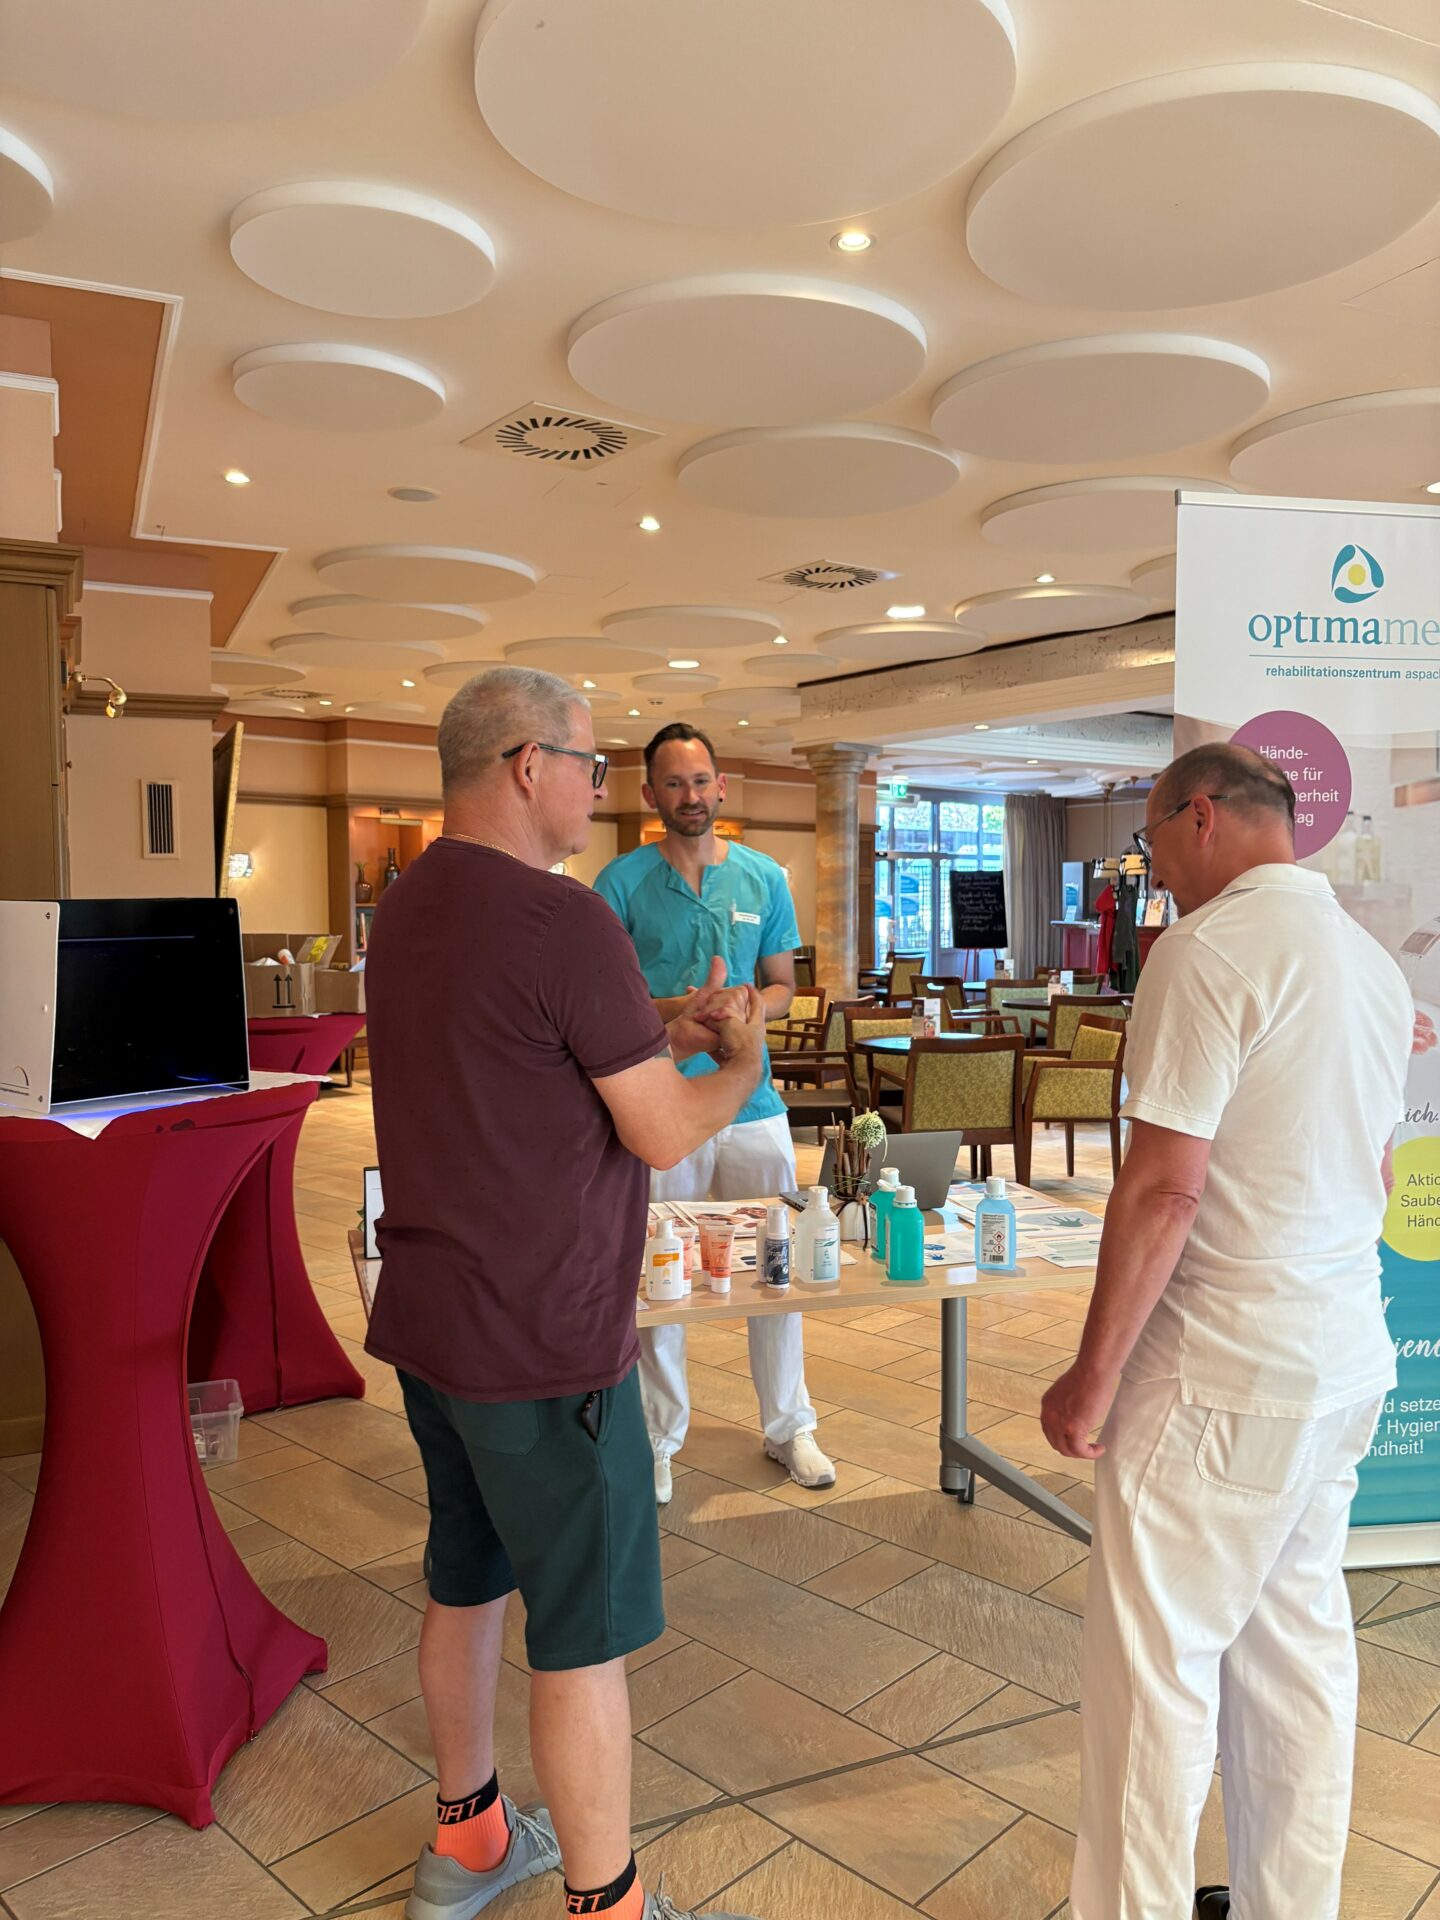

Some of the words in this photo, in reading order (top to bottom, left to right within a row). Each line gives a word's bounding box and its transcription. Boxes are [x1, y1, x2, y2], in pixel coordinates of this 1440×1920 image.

[1266, 665, 1401, 679] rehabilitationszentrum
[1405, 669, 1440, 682] aspac
[1260, 745, 1309, 760] Hände-
[1302, 767, 1324, 781] für
[1400, 1397, 1440, 1413] setze
